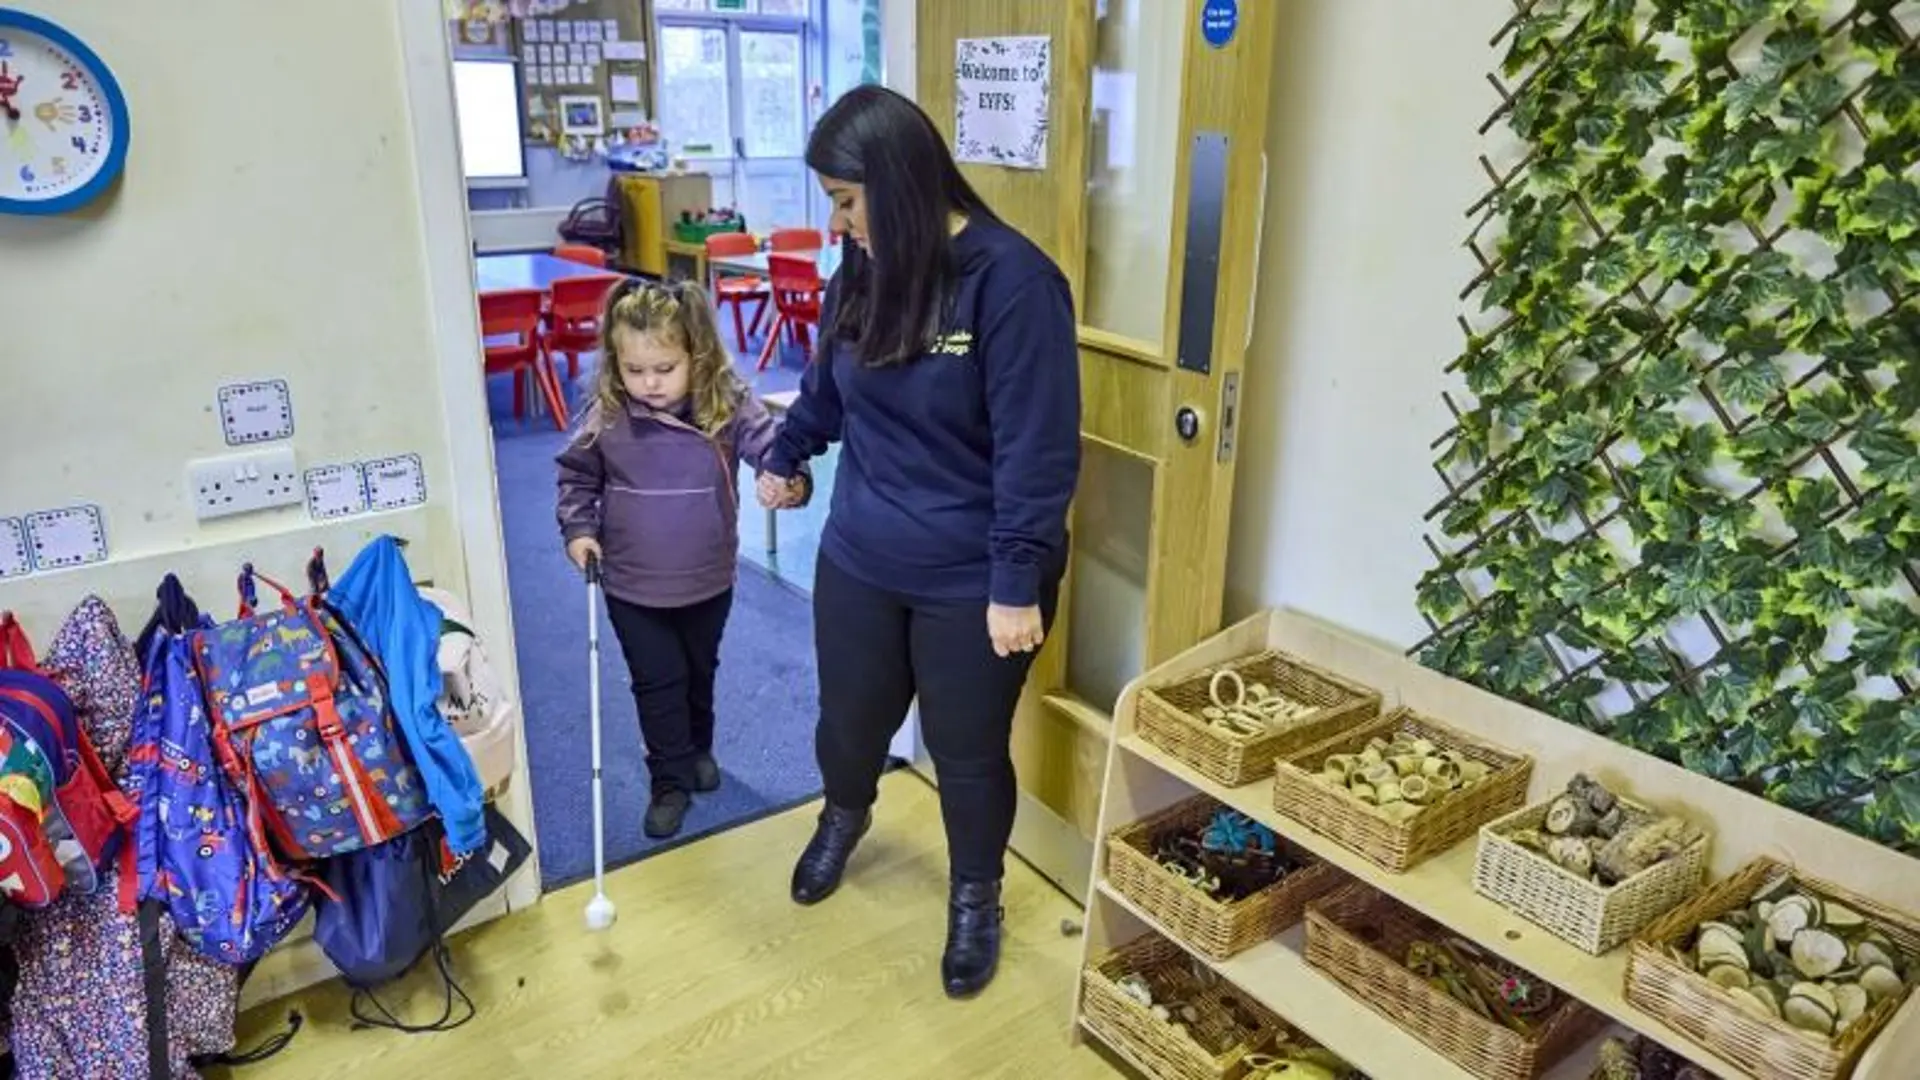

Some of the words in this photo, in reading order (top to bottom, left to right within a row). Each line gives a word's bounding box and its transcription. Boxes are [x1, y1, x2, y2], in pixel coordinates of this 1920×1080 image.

[60, 72, 78, 90] 2
[962, 63, 1018, 81] Welcome
[1023, 65, 1040, 82] to
[979, 92, 1016, 111] EYFS!
[78, 105, 92, 123] 3
[71, 136, 87, 154] 4
[20, 164, 35, 182] 6
